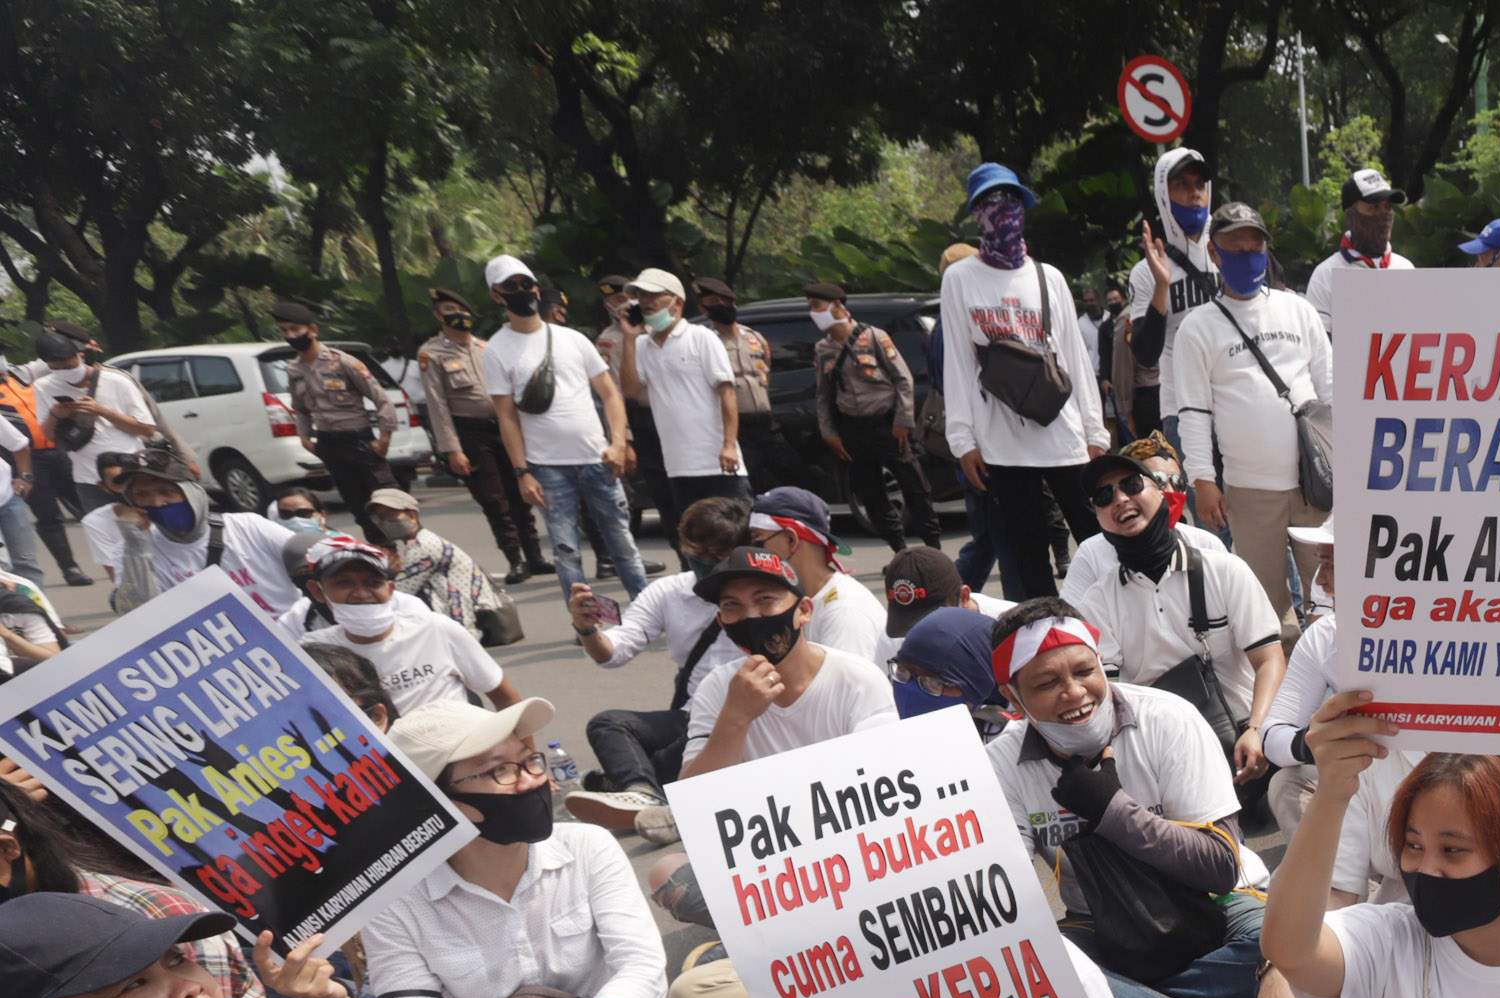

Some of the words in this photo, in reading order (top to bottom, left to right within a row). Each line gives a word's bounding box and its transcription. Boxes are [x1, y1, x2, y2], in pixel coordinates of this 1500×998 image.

[1364, 513, 1455, 583] Pak
[1358, 637, 1417, 675] BIAR
[1423, 640, 1487, 676] KAMI
[1361, 594, 1416, 629] ga
[16, 683, 128, 762] KAMI
[117, 611, 248, 702] SUDAH
[62, 703, 206, 805] SERING
[178, 646, 300, 740] LAPAR
[1415, 713, 1495, 726] KARYAWAN
[125, 786, 224, 858] Pak
[201, 733, 312, 815] Anies
[304, 736, 401, 826] kami
[714, 795, 803, 869] Pak
[809, 767, 921, 841] Anies
[225, 793, 337, 879] inget
[316, 874, 372, 921] KARYAWAN
[364, 843, 408, 884] HIBURAN
[401, 814, 446, 854] BERSATU
[732, 852, 851, 927] hidup
[856, 808, 985, 883] bukan
[197, 853, 262, 919] ga
[858, 863, 1018, 971] SEMBAKO
